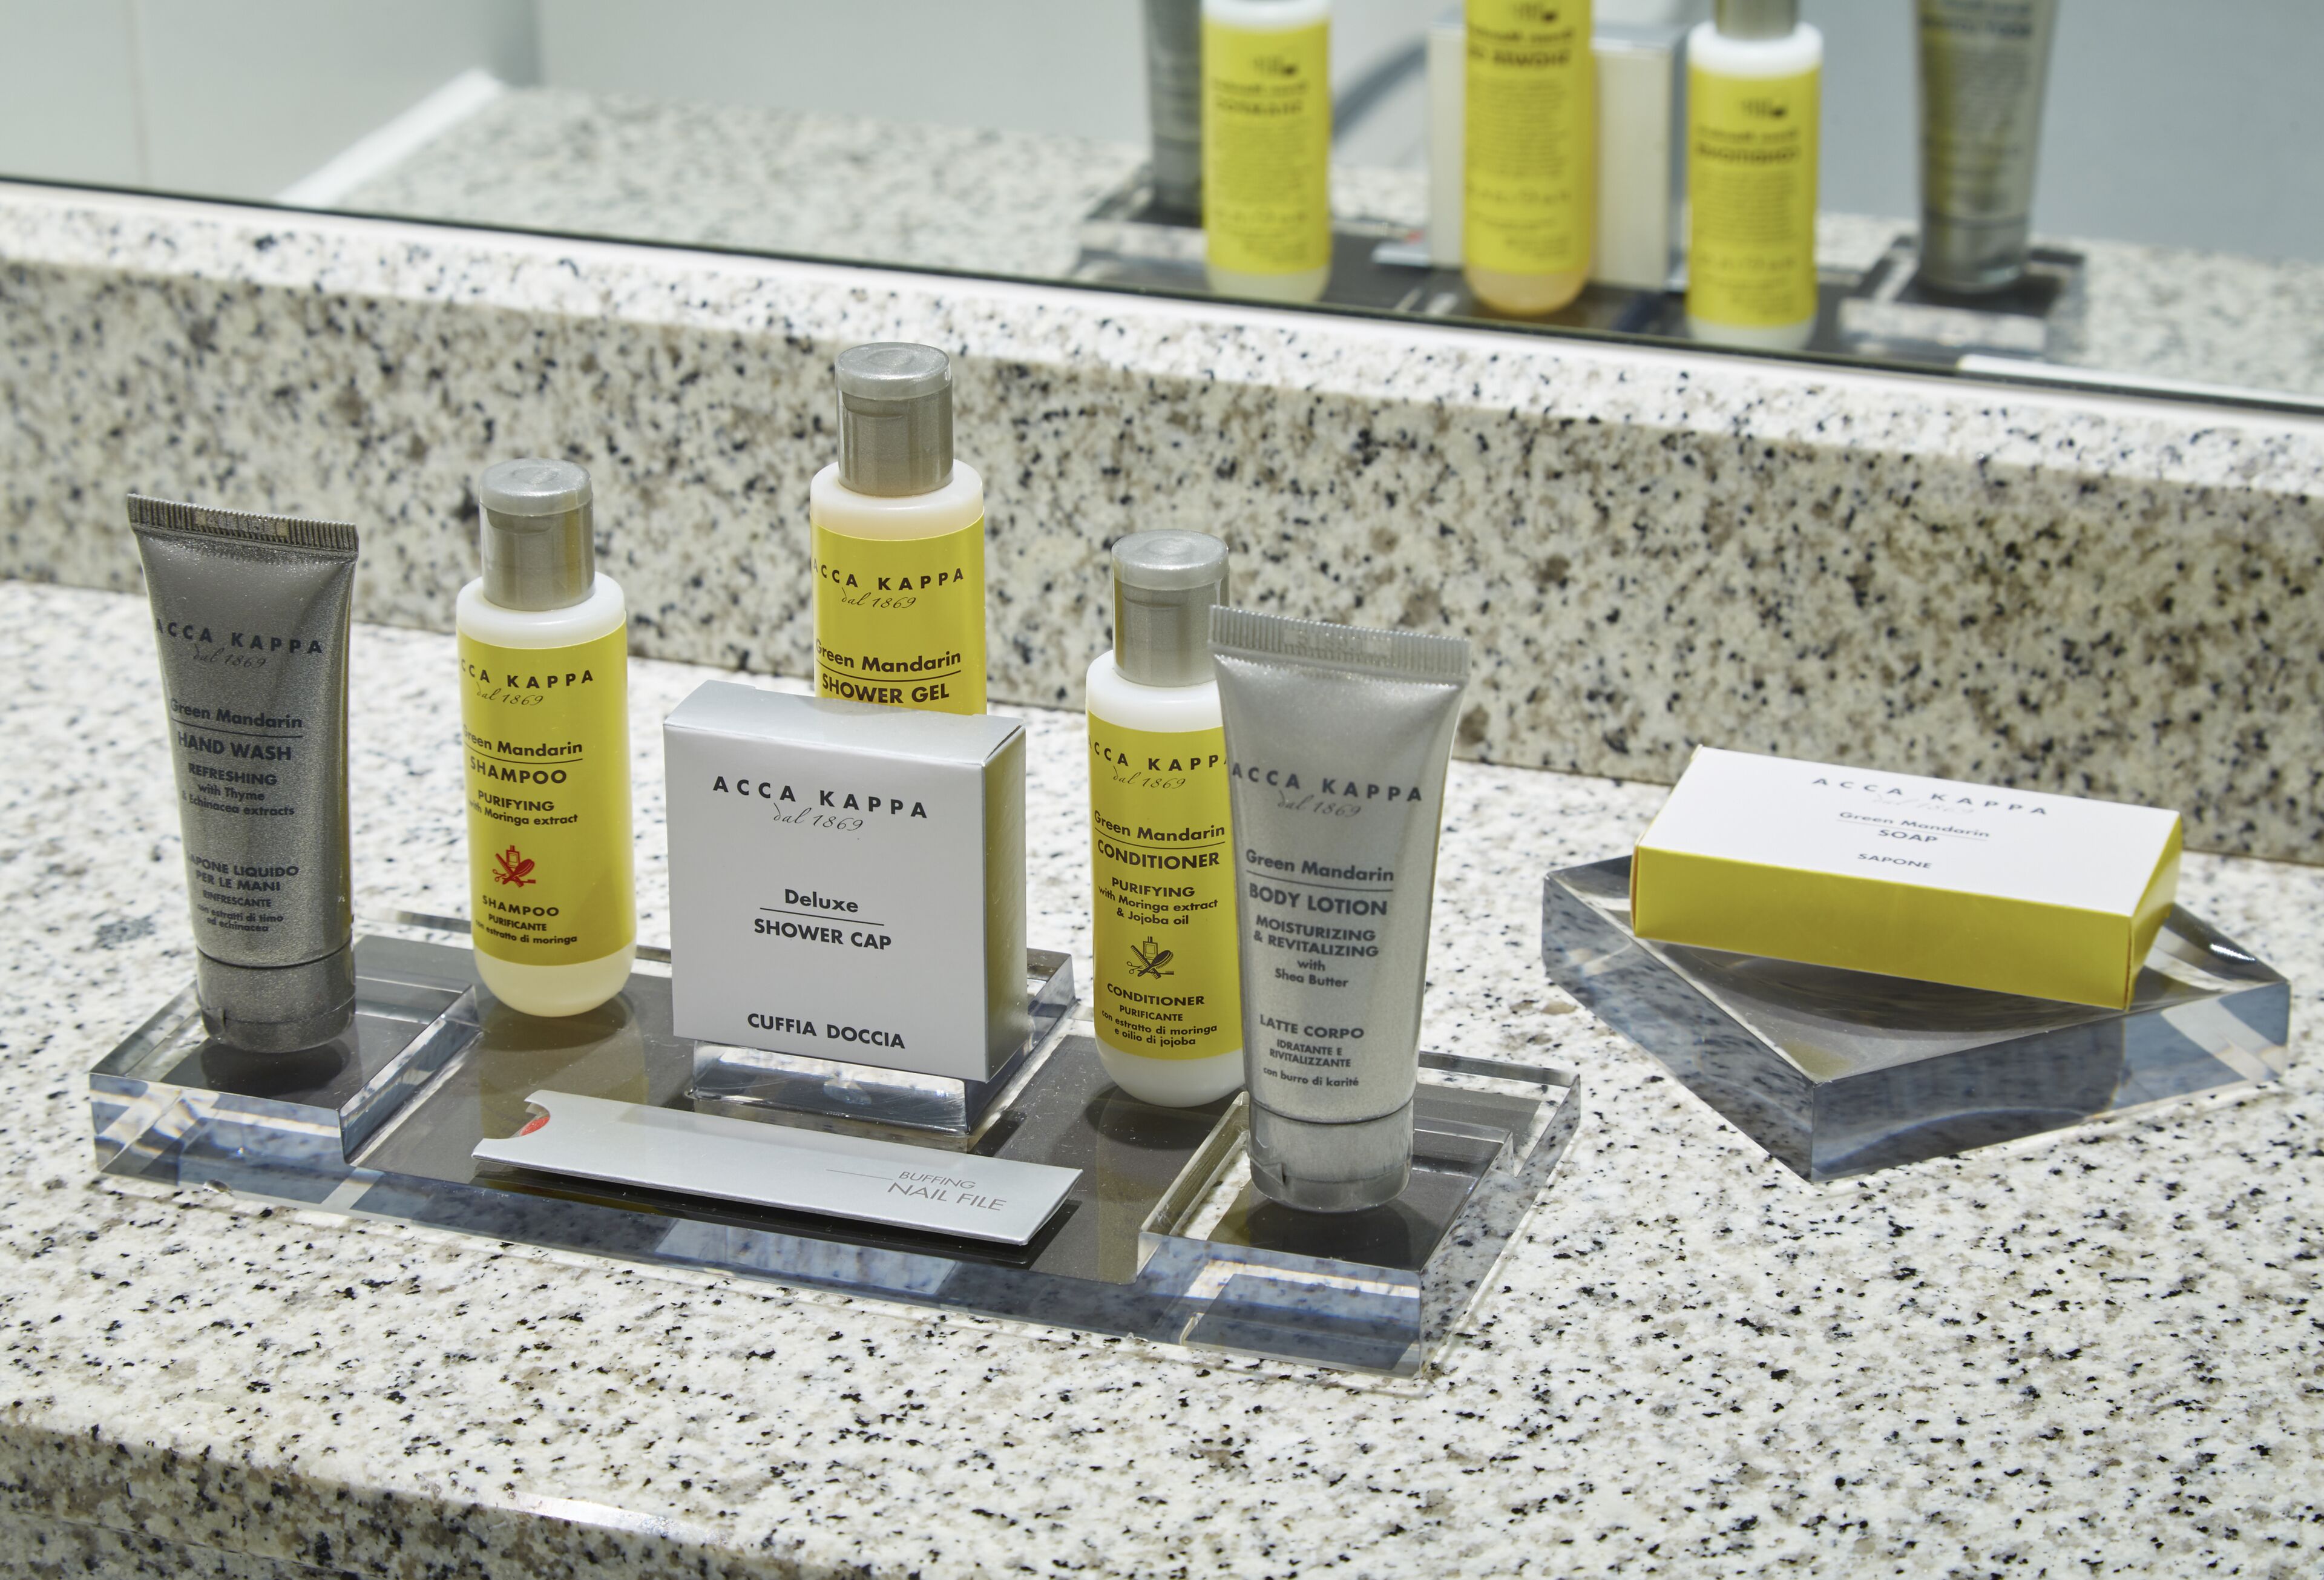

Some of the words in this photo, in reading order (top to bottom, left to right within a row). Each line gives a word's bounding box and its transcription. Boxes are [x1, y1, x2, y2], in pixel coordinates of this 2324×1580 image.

[813, 558, 858, 588] ACCA
[878, 568, 963, 591] KAPPA
[841, 587, 872, 606] dal
[872, 597, 916, 608] 1869
[156, 619, 212, 643] ACCA
[231, 632, 322, 654] KAPPA
[193, 644, 225, 662] dal
[225, 654, 266, 668] 1869
[816, 638, 854, 668] Green
[861, 651, 961, 673] Mandarin
[461, 659, 490, 683] CCA
[507, 670, 593, 689] KAPPA
[476, 682, 502, 700] dal
[502, 695, 543, 706] 1869
[822, 673, 904, 703] SHOWER
[911, 683, 950, 703] GEL
[170, 698, 211, 719] Green
[216, 709, 302, 728] Mandarin
[178, 731, 225, 754] HAND
[230, 742, 292, 760] WASH
[464, 724, 492, 751] Green
[497, 740, 582, 757] Mandarin
[188, 763, 277, 785] REFRESHING
[470, 755, 567, 785] SHAMPOO
[1148, 755, 1227, 772] KAPP
[1113, 765, 1141, 785] dal
[1143, 778, 1186, 789] 1869
[1232, 762, 1300, 789] ACCA
[1322, 778, 1422, 802] KAPPA
[189, 794, 239, 814] Echinacea
[244, 806, 295, 816] extracts
[198, 784, 221, 796] with
[225, 787, 264, 802] Thyme
[478, 789, 554, 812] PURIFYING
[712, 776, 796, 802] ACCA
[820, 790, 927, 818] KAPPA
[1278, 789, 1315, 810] dal
[1313, 802, 1361, 817] 1869
[1812, 778, 1903, 795] ACCA
[1930, 793, 2047, 815] KAPPA
[469, 798, 482, 814] with
[485, 807, 530, 826] Moringa
[534, 814, 578, 825] extract
[773, 802, 812, 824] dal
[812, 814, 863, 831] 1869
[1094, 810, 1131, 837] Green
[1137, 825, 1225, 841] Mandarin
[1839, 811, 1894, 825] Green
[1900, 820, 1990, 838] Mandarin
[1878, 829, 1938, 843] SOAP
[188, 854, 229, 875] APONE
[234, 865, 300, 878] LIQUIDO
[1098, 839, 1220, 870] CONDITIONER
[1246, 849, 1295, 872] Green
[1302, 860, 1394, 881] Mandarin
[1857, 853, 1932, 869] SAPONE
[196, 870, 214, 885] PER
[219, 877, 231, 889] LE
[237, 881, 281, 892] MANI
[1112, 877, 1195, 897] PURIFYING
[203, 890, 272, 907] RINFRESCANTE
[482, 895, 559, 917] SHAMPOO
[785, 889, 859, 913] Deluxe
[1098, 886, 1115, 901] with
[1118, 894, 1169, 913] Moringa
[1173, 899, 1218, 912] extract
[1249, 883, 1301, 908] BODY
[1308, 895, 1387, 915] LOTION
[207, 917, 216, 926] ed
[219, 920, 269, 932] echinacea
[212, 910, 242, 921] estratti
[246, 912, 256, 922] di
[260, 914, 284, 923] timo
[488, 913, 547, 931] PURIFICANTE
[1117, 907, 1125, 918] &
[1128, 911, 1169, 925] Jojoba
[1173, 915, 1189, 925] oil
[1256, 915, 1376, 941] MOISTURIZING
[486, 927, 517, 941] estratto
[520, 935, 530, 943] di
[533, 935, 577, 945] moringa
[754, 918, 844, 945] SHOWER
[850, 932, 891, 950] CAP
[1253, 930, 1262, 943] &
[1269, 935, 1379, 957] REVITALIZING
[1297, 959, 1325, 972] with
[1275, 968, 1304, 984] Shea
[1308, 974, 1348, 988] Butter
[1107, 983, 1205, 1006] CONDITIONER
[1101, 1009, 1113, 1022] con
[1115, 1017, 1152, 1034] estratto
[1155, 1025, 1166, 1035] di
[1170, 1025, 1218, 1036] moringa
[1119, 1004, 1183, 1022] PURIFICANTE
[747, 1013, 817, 1036] CUFFIA
[827, 1024, 905, 1049] DOCCIA
[1260, 1014, 1298, 1034] LATTE
[1304, 1025, 1365, 1039] CORPO
[1122, 1030, 1143, 1042] oilio
[1146, 1035, 1156, 1044] di
[1160, 1036, 1196, 1048] jojoba
[1277, 1039, 1332, 1055] IDRATANTE
[1337, 1047, 1342, 1056] E
[1270, 1048, 1351, 1067] RIVITALIZZANTE
[1263, 1066, 1277, 1078] con
[1281, 1070, 1308, 1084] burro
[1312, 1076, 1322, 1085] di
[1327, 1077, 1359, 1086] karité
[898, 1171, 976, 1189] BUFFING
[887, 1182, 947, 1202] NAIL
[956, 1193, 1006, 1211] FILE
